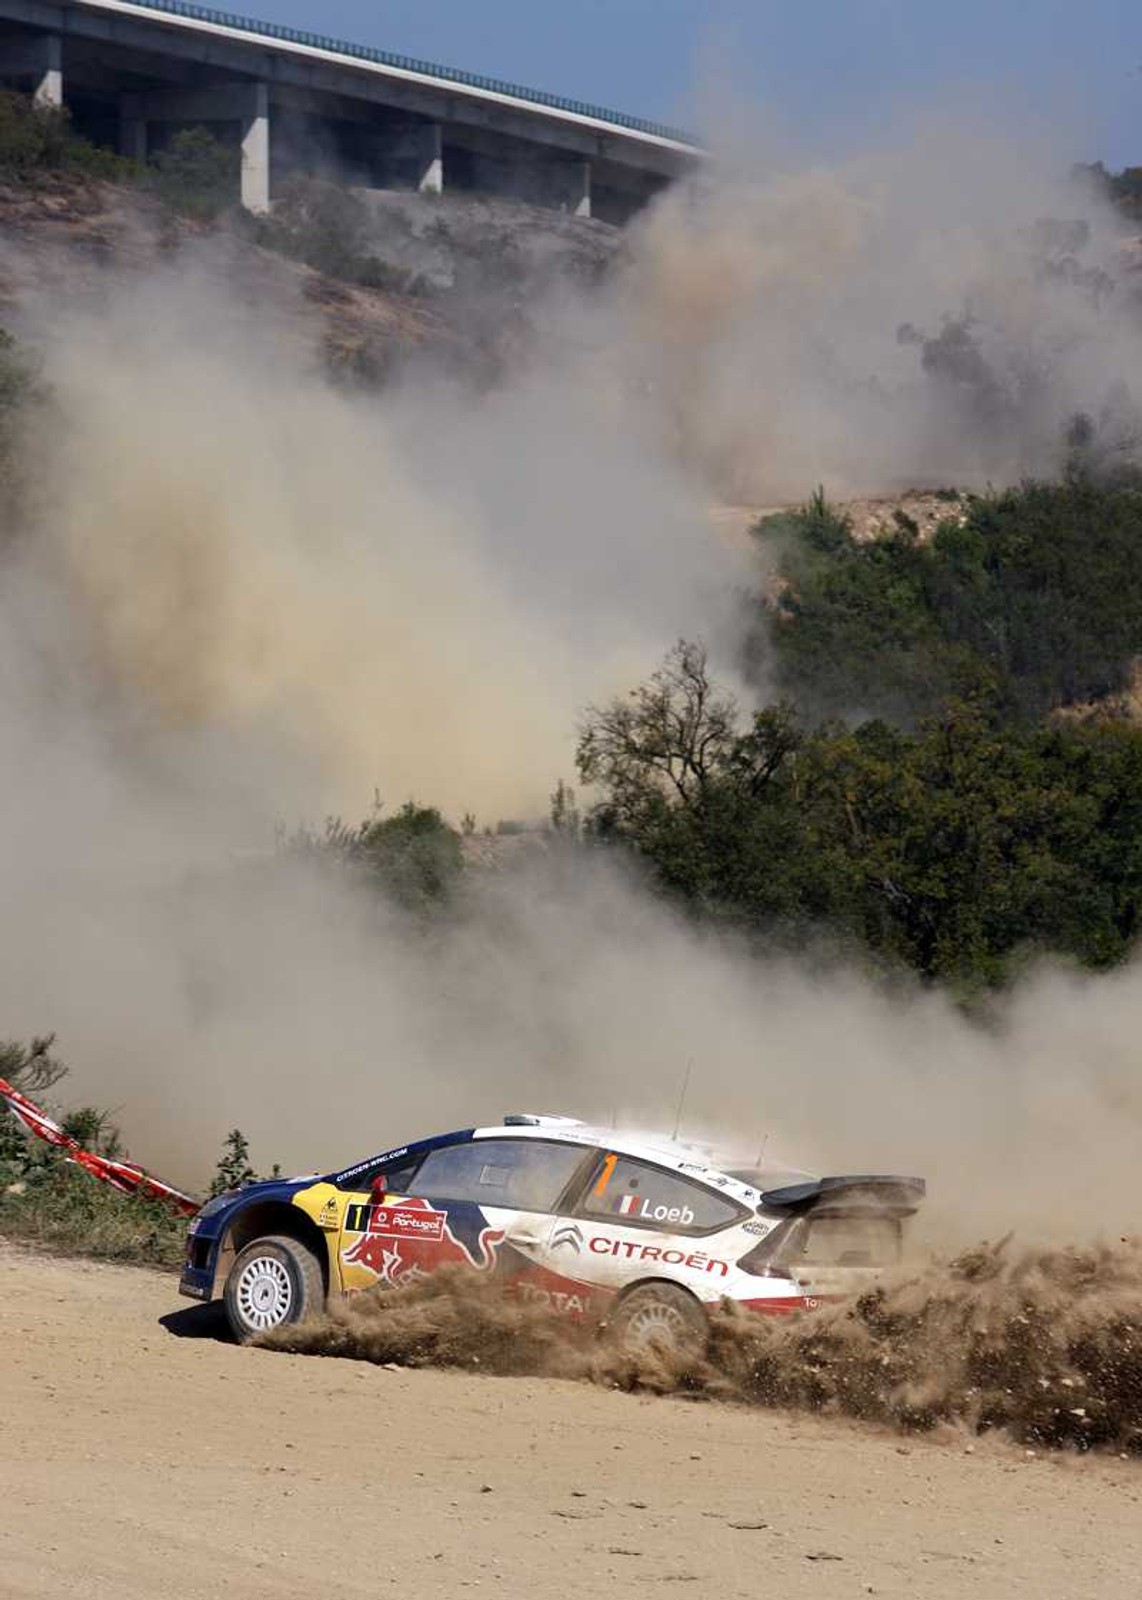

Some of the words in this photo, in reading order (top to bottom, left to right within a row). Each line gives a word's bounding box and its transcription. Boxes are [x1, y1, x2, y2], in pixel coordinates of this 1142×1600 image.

[354, 1206, 363, 1230] 1
[393, 1217, 440, 1230] Portugal
[640, 1199, 694, 1224] Loeb
